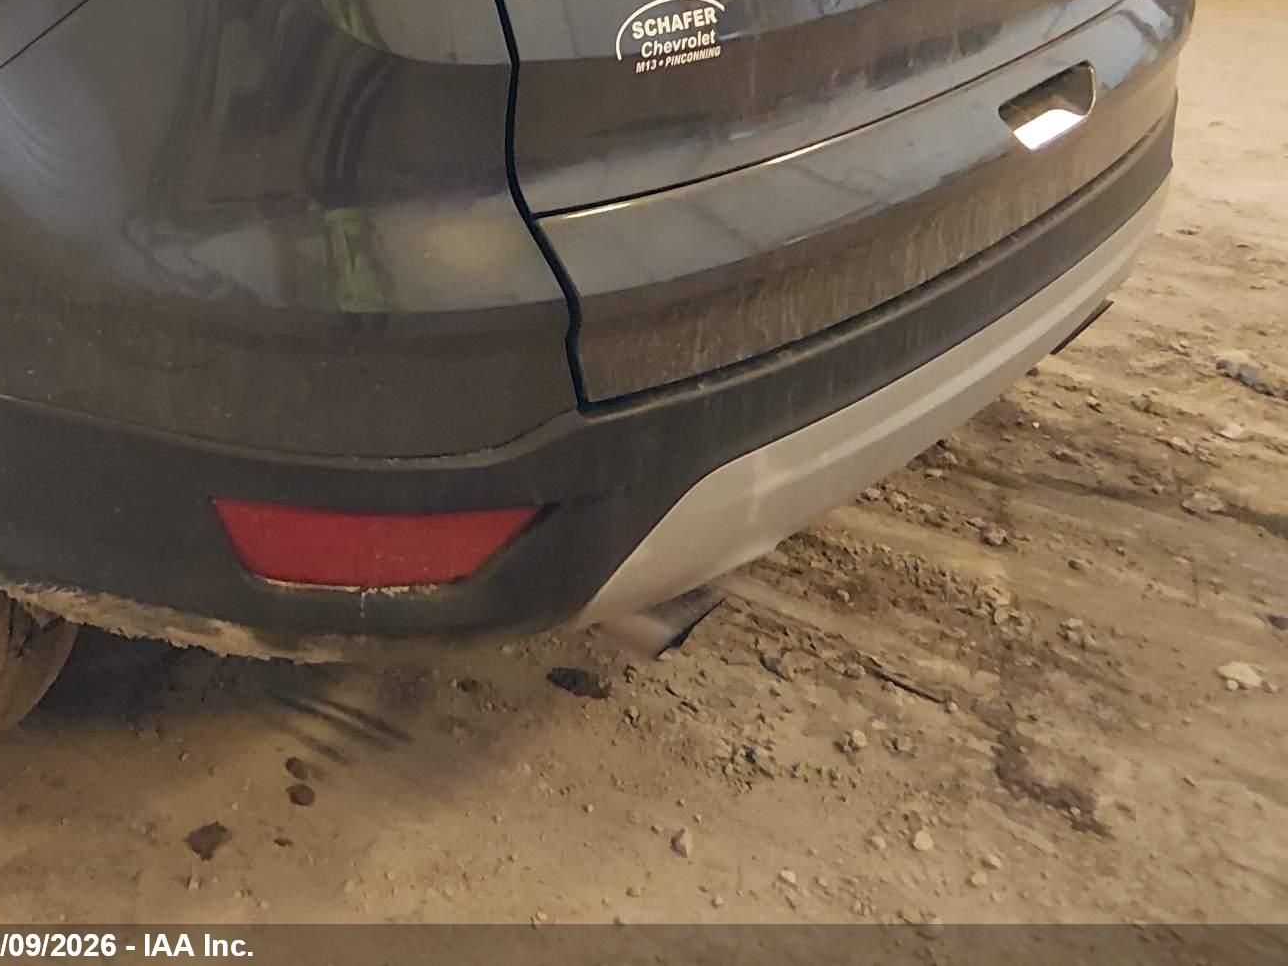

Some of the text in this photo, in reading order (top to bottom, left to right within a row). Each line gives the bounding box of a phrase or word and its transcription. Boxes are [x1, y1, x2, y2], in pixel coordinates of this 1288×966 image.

[631, 6, 718, 40] SCHAFER
[641, 28, 716, 58] Chevrolet
[635, 45, 722, 74] M13 PINCONNING
